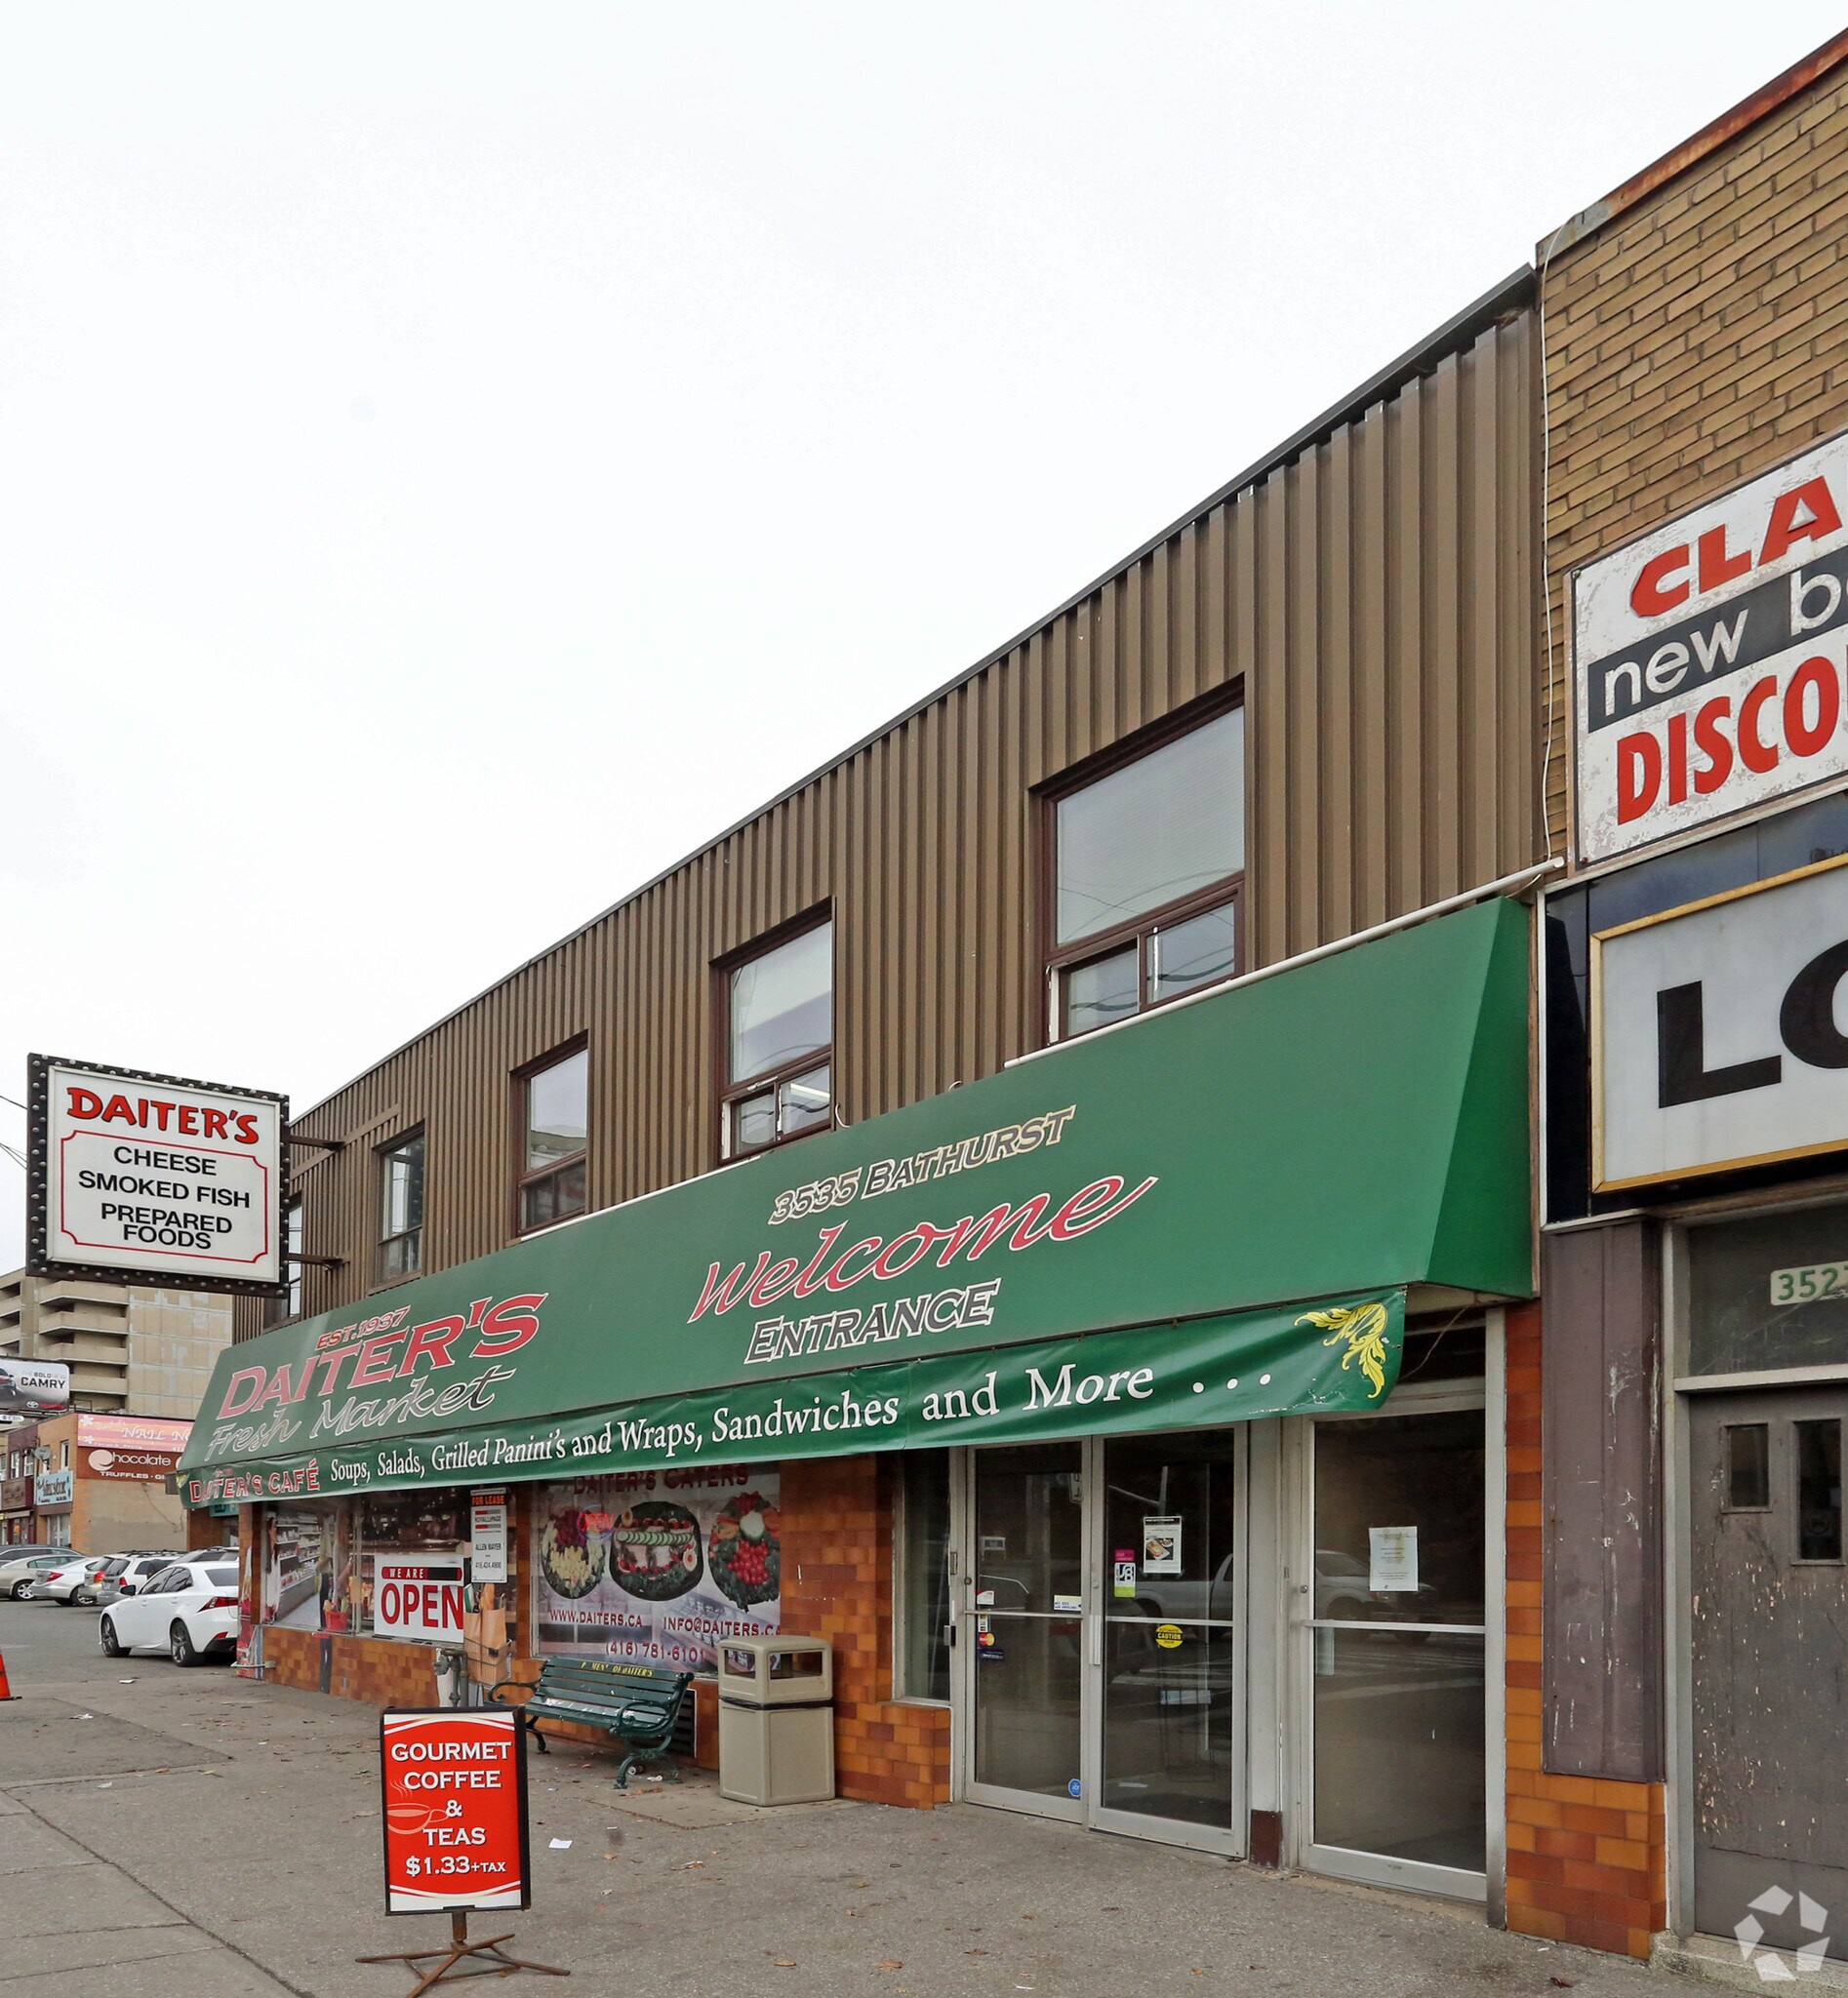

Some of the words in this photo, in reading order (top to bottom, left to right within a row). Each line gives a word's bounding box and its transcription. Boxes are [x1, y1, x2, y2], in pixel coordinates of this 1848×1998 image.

[1629, 475, 1843, 618] CLA
[1604, 609, 1749, 717] new
[1788, 570, 1848, 637] b
[1616, 655, 1848, 826] DISCO
[66, 1087, 260, 1145] DAITER'S
[113, 1146, 217, 1177] CHEESE
[767, 1167, 863, 1226] 3535
[861, 1103, 1077, 1201] BATHURST
[78, 1170, 189, 1200] SMOKED
[196, 1185, 251, 1209] FISH
[100, 1202, 233, 1234] PREPARED
[123, 1224, 212, 1250] FOODS
[687, 1175, 1160, 1325] Welcome
[1777, 1265, 1848, 1301] 352
[314, 1304, 412, 1350] EST.1937
[743, 1277, 1002, 1365] ENTRANCE
[217, 1292, 549, 1420] DAITER'S
[20, 1377, 66, 1389] CAMRY
[204, 1407, 302, 1462] Fresh
[308, 1365, 517, 1440] Market
[330, 1458, 371, 1487] Soups,
[377, 1449, 425, 1479] Salads,
[431, 1438, 489, 1471] Grilled
[492, 1427, 566, 1465] Panini's
[572, 1421, 613, 1458] and
[619, 1415, 704, 1459] Wraps,
[711, 1388, 900, 1443] Sandwiches
[921, 1373, 1001, 1421] and
[1022, 1363, 1155, 1411] More
[100, 1470, 149, 1480] TRUFFLES
[267, 1459, 321, 1494] CAFÉ
[663, 1463, 748, 1490] CATERS
[471, 1497, 484, 1505] FOR
[485, 1495, 505, 1504] LEASE
[578, 1512, 615, 1532] OPEN
[389, 1568, 402, 1578] WE
[406, 1568, 424, 1578] ARE
[381, 1582, 464, 1630] OPEN
[549, 1610, 643, 1628] WWW.DAITERS.CA
[605, 1640, 637, 1658] (416)
[390, 1741, 512, 1762] GOURMET
[403, 1770, 502, 1790] COFFEE
[446, 1799, 462, 1818] &
[422, 1827, 487, 1847] TEAS
